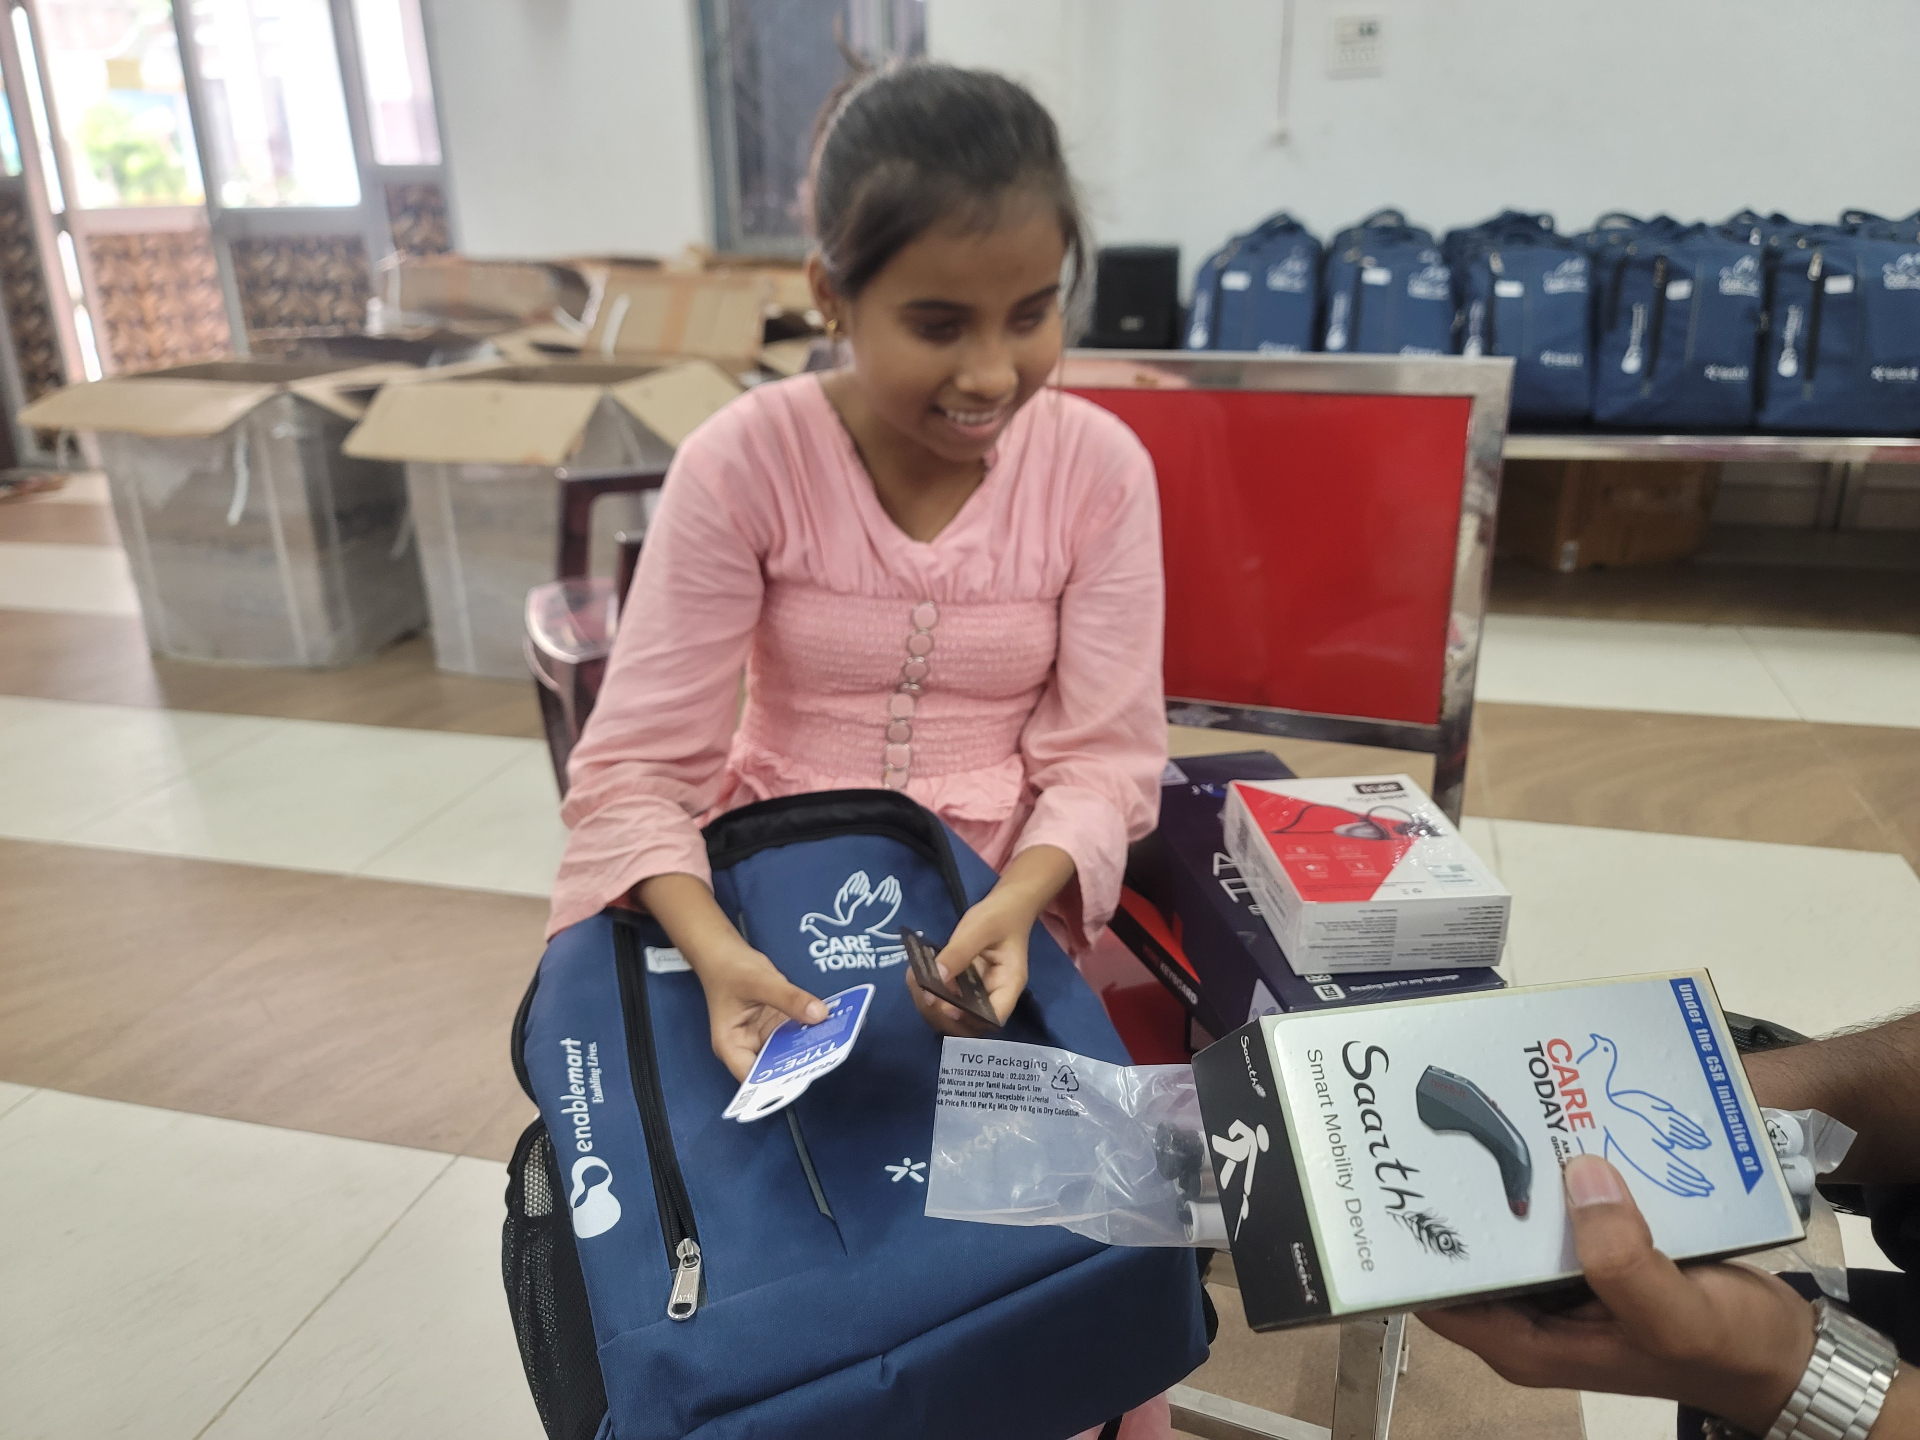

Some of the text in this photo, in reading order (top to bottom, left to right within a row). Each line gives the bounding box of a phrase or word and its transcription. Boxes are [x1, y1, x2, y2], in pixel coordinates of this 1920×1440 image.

[809, 934, 875, 958] CARE
[813, 953, 876, 973] TODAY
[756, 1042, 838, 1083] TYPE-C
[960, 1053, 1048, 1071] TVC Packaging
[589, 1067, 604, 1103] Enabling
[946, 1078, 966, 1087] Micron
[975, 1081, 984, 1089] per
[986, 1081, 1001, 1089] Tamil
[1033, 1084, 1043, 1093] law
[992, 1071, 1005, 1079] Date
[1060, 1073, 1069, 1085] 4
[1547, 1038, 1596, 1132] CARE
[1678, 984, 1759, 1172] Under the CSR Initiative of
[559, 1038, 593, 1152] enablemart
[954, 1088, 977, 1098] Material
[978, 1091, 994, 1099] 100%
[995, 1092, 1025, 1102] Recyclable
[1523, 1040, 1569, 1133] TODAY
[945, 1099, 959, 1107] Price
[960, 1100, 977, 1108] Rs.10
[978, 1101, 987, 1109] Per
[988, 1102, 996, 1111] Kg
[1009, 1103, 1019, 1113] Qty
[1028, 1105, 1036, 1114] Kg
[1044, 1107, 1054, 1116] Dry
[1769, 1128, 1777, 1140] 4
[1307, 1048, 1375, 1272] Smart Mobility Device
